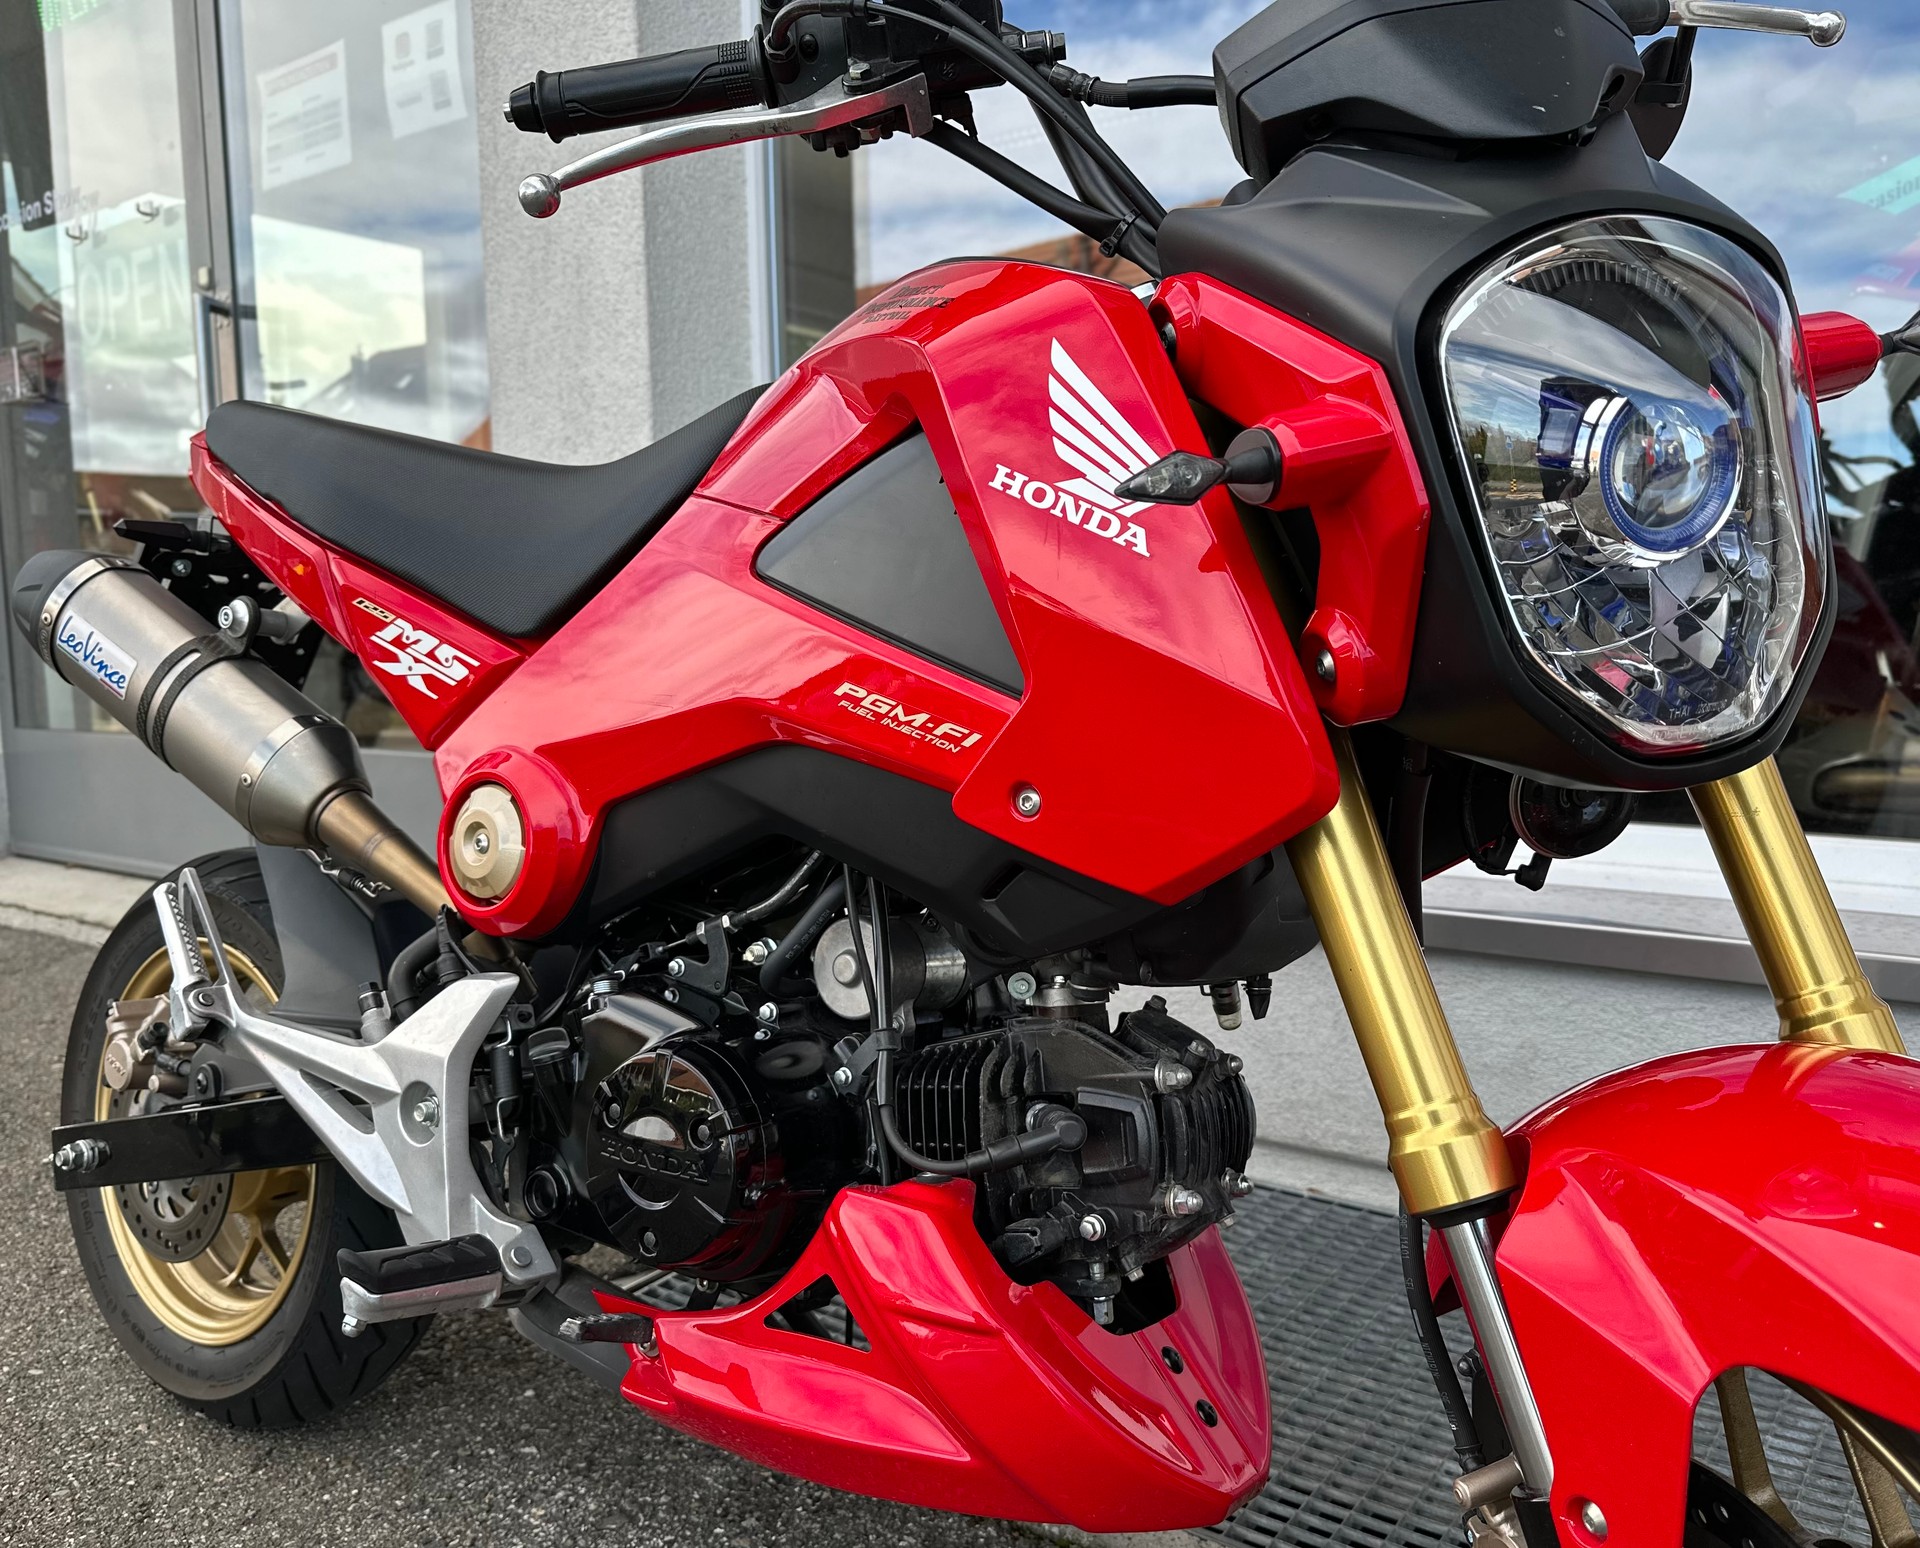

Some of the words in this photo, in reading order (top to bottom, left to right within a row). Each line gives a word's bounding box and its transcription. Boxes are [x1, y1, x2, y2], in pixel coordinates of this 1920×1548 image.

[988, 463, 1150, 558] HONDA
[58, 615, 126, 689] LeoVince
[833, 681, 983, 748] PGM-FI
[837, 699, 876, 721] FUEL
[880, 717, 962, 753] INJECTION
[600, 1136, 710, 1183] HONDA
